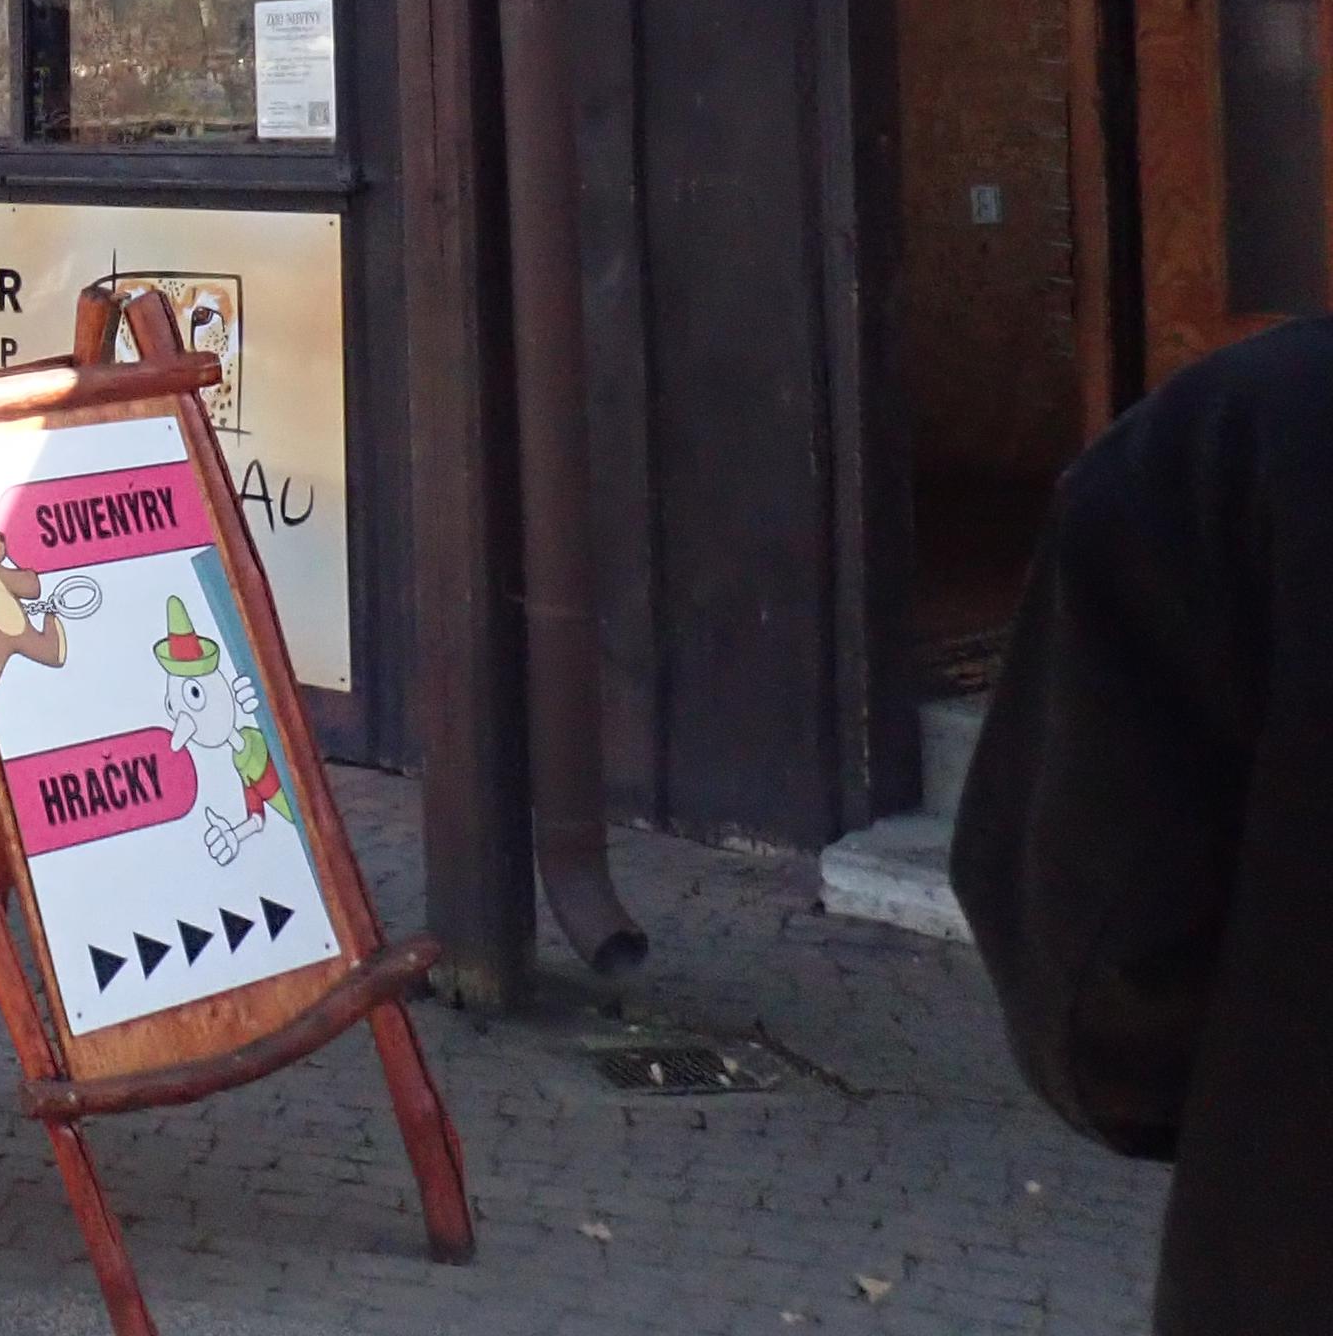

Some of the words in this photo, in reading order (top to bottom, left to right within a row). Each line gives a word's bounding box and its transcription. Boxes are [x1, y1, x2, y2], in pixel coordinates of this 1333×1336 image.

[35, 480, 180, 549] SUVENÝRY
[236, 458, 314, 534] AU
[39, 751, 164, 827] HRAČKY
